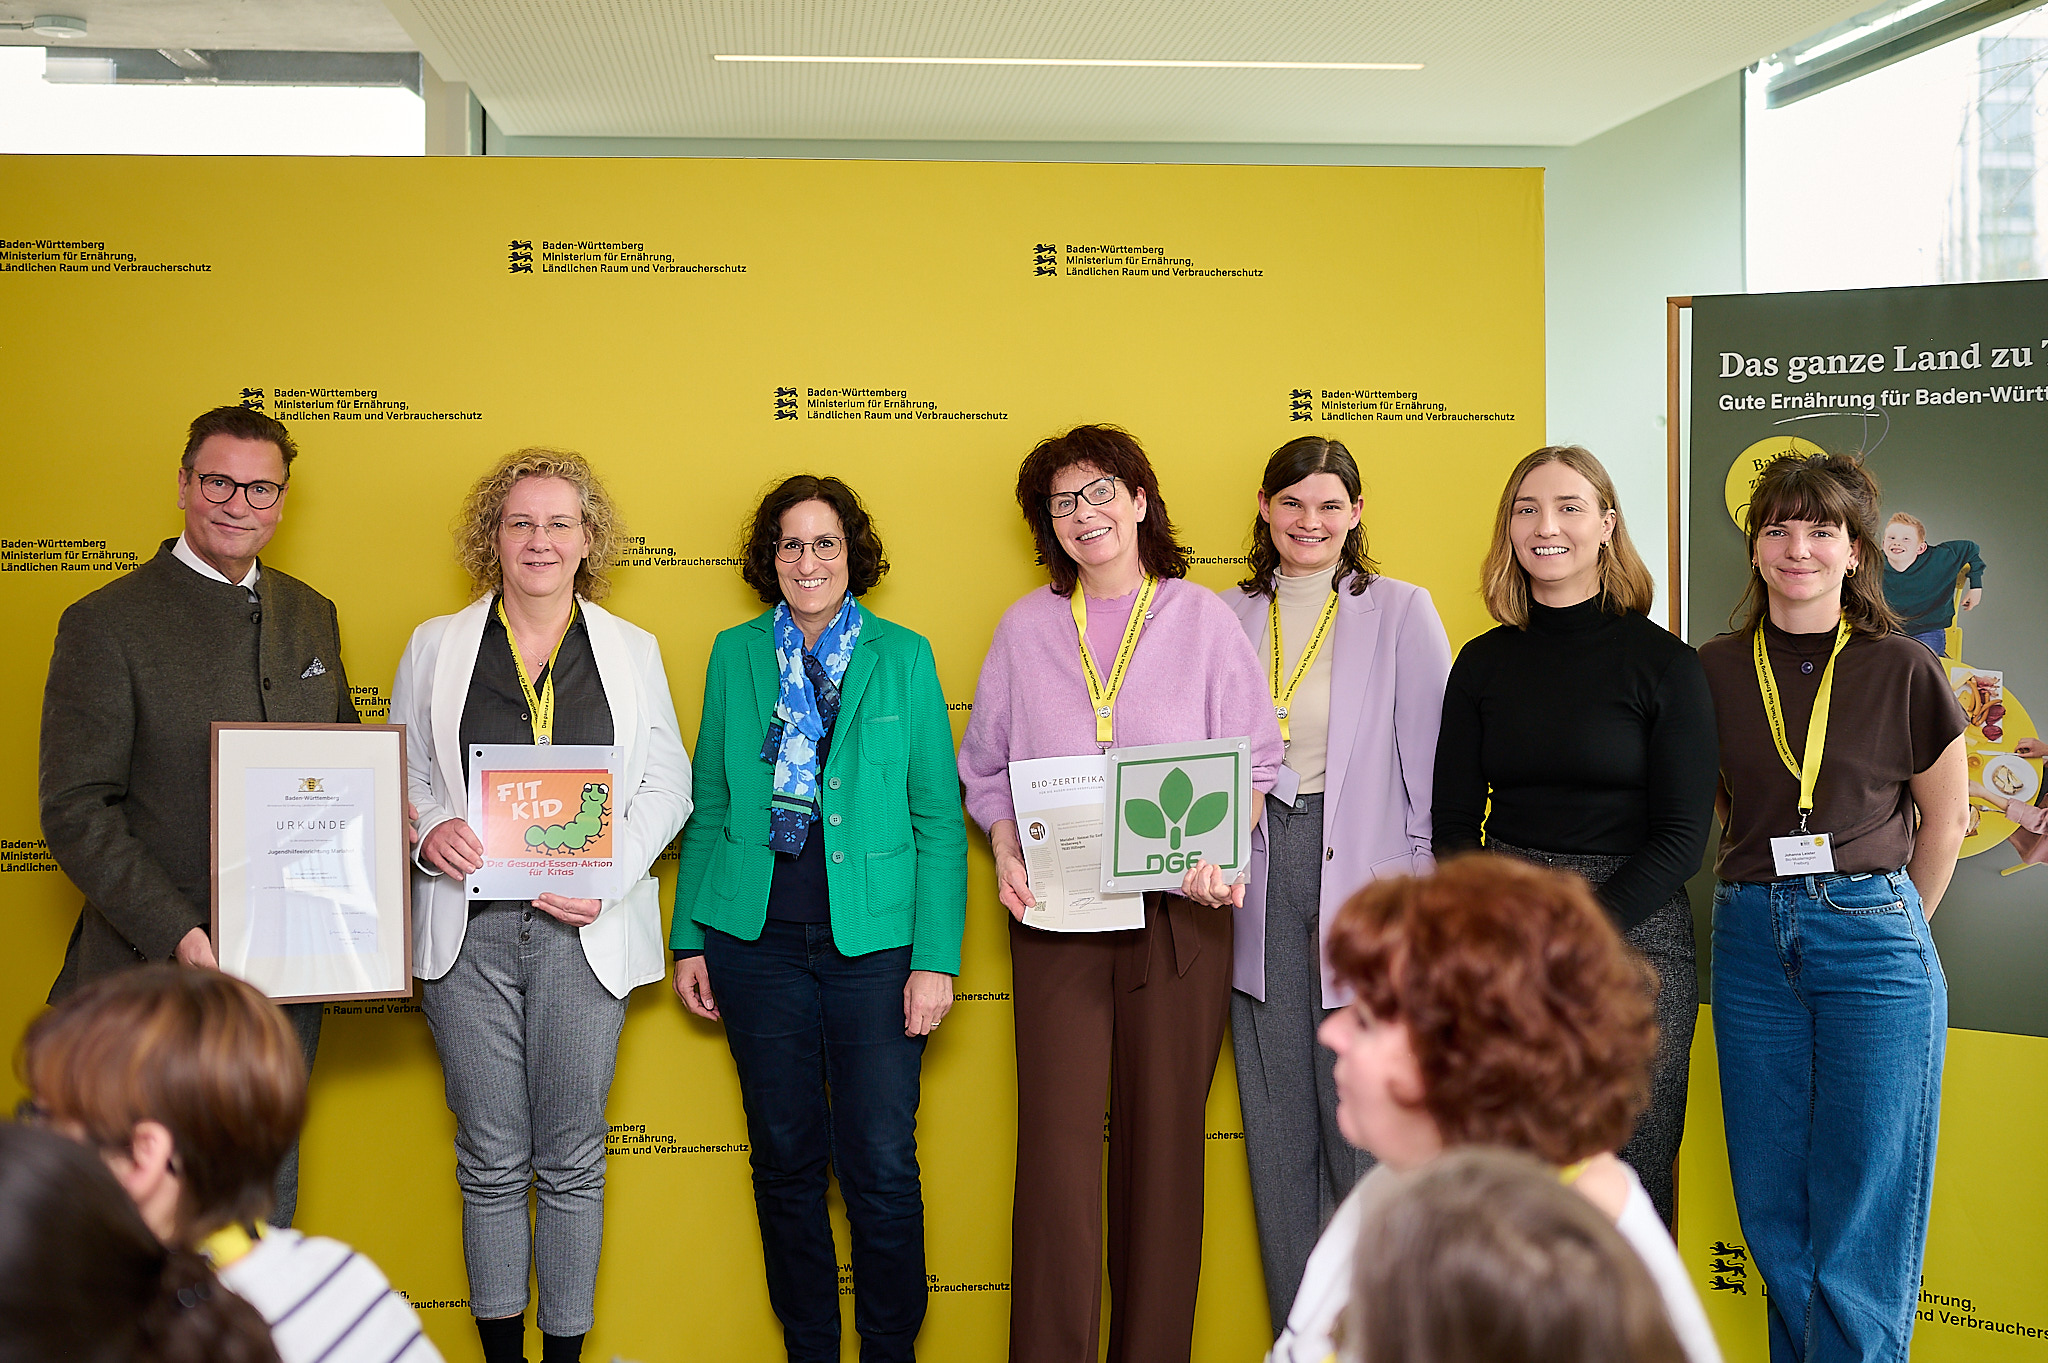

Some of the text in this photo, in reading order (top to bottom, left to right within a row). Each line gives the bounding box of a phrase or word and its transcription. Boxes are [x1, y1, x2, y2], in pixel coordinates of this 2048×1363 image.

[0, 240, 105, 250] Baden-Württemberg
[542, 242, 644, 250] Baden-Württemberg
[1066, 245, 1164, 255] Baden-Württemberg
[0, 252, 137, 262] Ministerium für Ernährung,
[542, 253, 675, 263] Ministerium für Ernährung,
[1066, 256, 1194, 267] Ministerium für Ernährung,
[0, 263, 211, 272] Ländlichen Raum und Verbraucherschutz
[542, 264, 747, 272] Ländlichen Raum und Verbraucherschutz
[1066, 268, 1263, 277] Ländlichen Raum und Verbraucherschutz
[1719, 352, 1779, 378] Das
[1787, 349, 1885, 384] ganze
[1893, 342, 1982, 372] Land
[1991, 345, 2033, 369] zu
[274, 389, 377, 398] Baden-Württemberg
[807, 388, 906, 398] Baden-Württemberg
[1322, 390, 1417, 400] Baden-Württemberg
[1719, 384, 2048, 411] Gute Ernährung für Baden-Württ
[274, 400, 409, 410] Ministerium für Ernährung,
[807, 400, 937, 410] Ministerium für Ernährung,
[1322, 401, 1447, 411] Ministerium für Ernährung,
[274, 411, 482, 420] Ländlichen Raum und Verbraucherschutz
[807, 411, 1008, 420] Ländlichen Raum und Verbraucherschutz
[1322, 413, 1515, 421] Ländlichen Raum und Verbraucherschutz
[1, 539, 106, 548] Baden-Württemberg
[1, 551, 138, 560] Ministerium für Ernährung,
[1, 563, 57, 571] Ländlichen
[61, 563, 89, 571] Raum
[93, 562, 112, 570] und
[633, 558, 651, 566] und
[366, 708, 384, 716] und
[1031, 775, 1105, 789] BIO-ZERTIFIKA
[497, 780, 542, 802] FIT
[511, 799, 563, 821] KID
[276, 820, 347, 831] URKUNDE
[1, 851, 54, 860] Ministeriu
[488, 860, 613, 868] Die Gesund-Essen-Aktion
[1146, 850, 1202, 874] DGE
[1, 863, 58, 872] Ländlichen
[529, 868, 574, 876] für Kitas
[334, 1006, 362, 1014] Raum
[364, 1005, 384, 1014] und
[605, 1134, 677, 1144] für Ernährung,
[633, 1146, 651, 1154] und
[654, 1144, 749, 1154] Verbraucherschutz
[1917, 1289, 1977, 1312] ährung,
[1940, 1310, 2048, 1338] Verbrauchers
